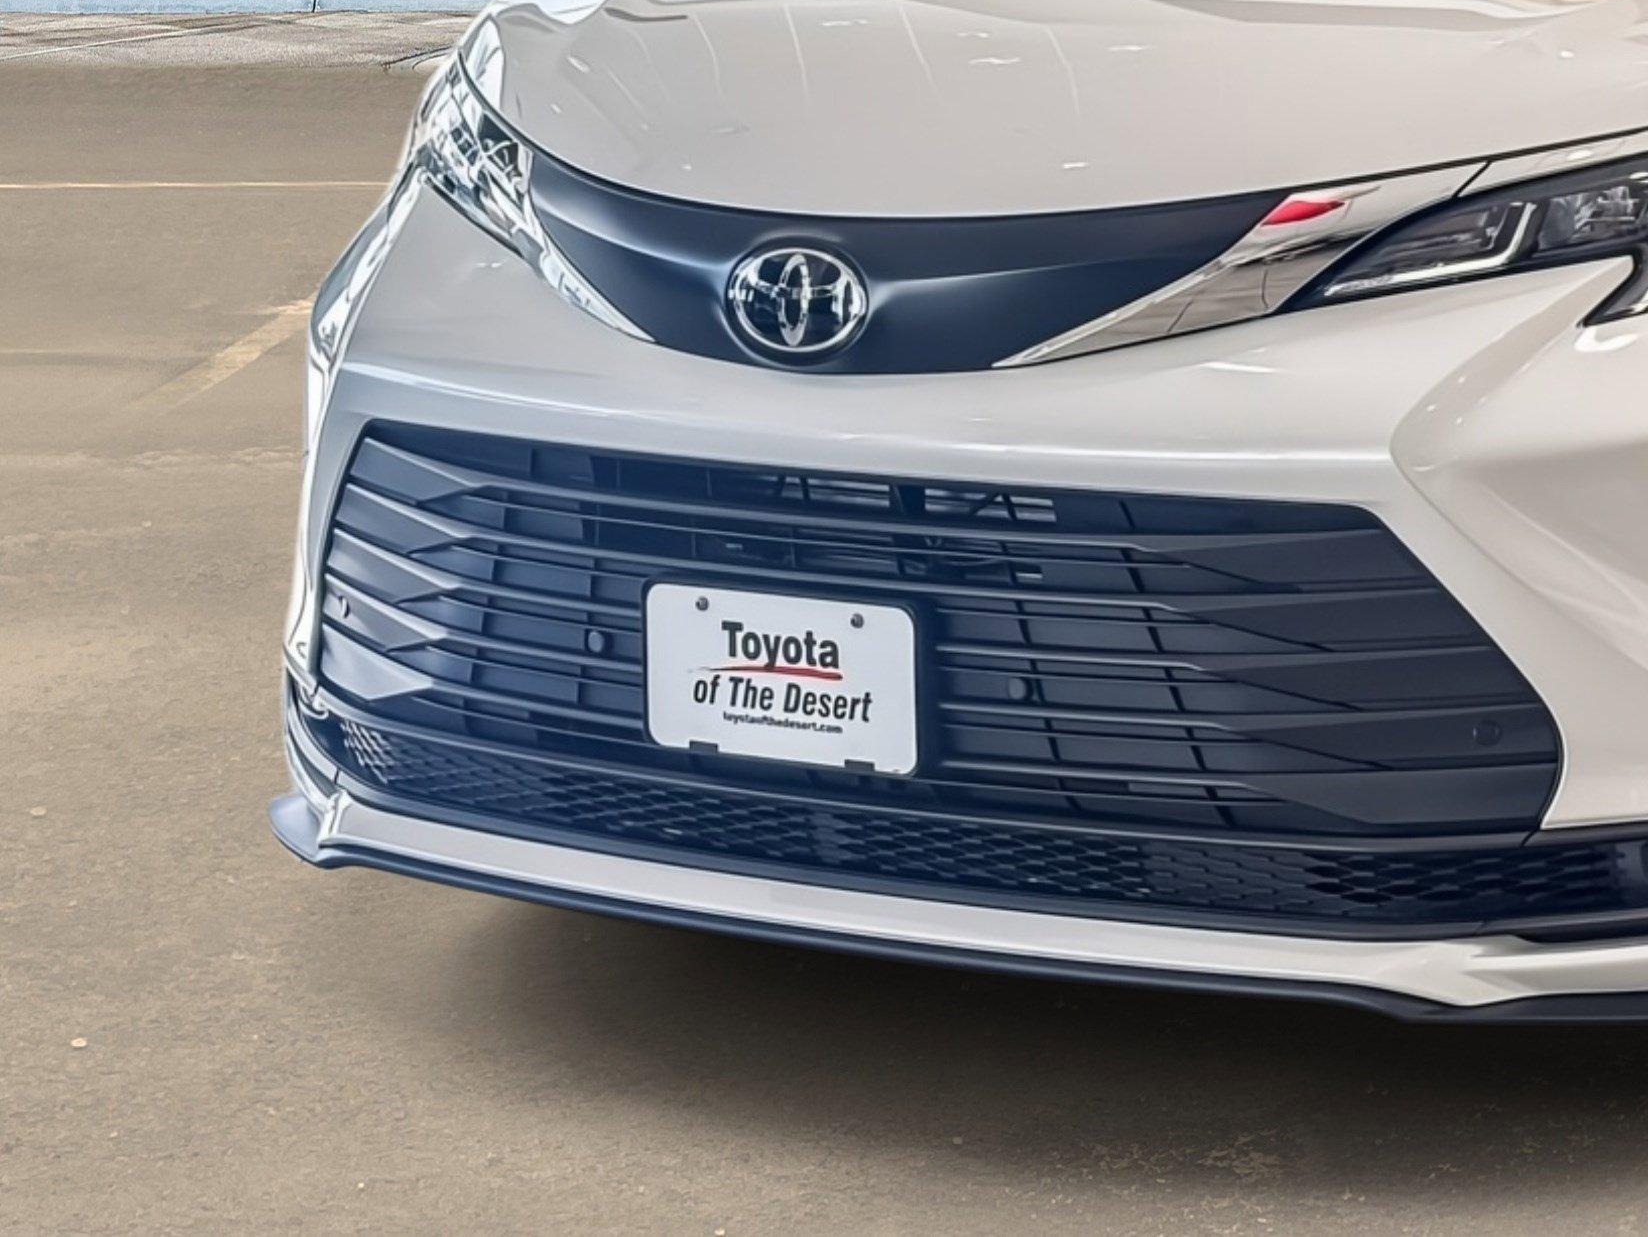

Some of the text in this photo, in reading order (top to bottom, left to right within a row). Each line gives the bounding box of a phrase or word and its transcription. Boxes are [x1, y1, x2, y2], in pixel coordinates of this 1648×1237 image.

[721, 620, 840, 670] Toyota
[693, 674, 873, 723] of The Desert
